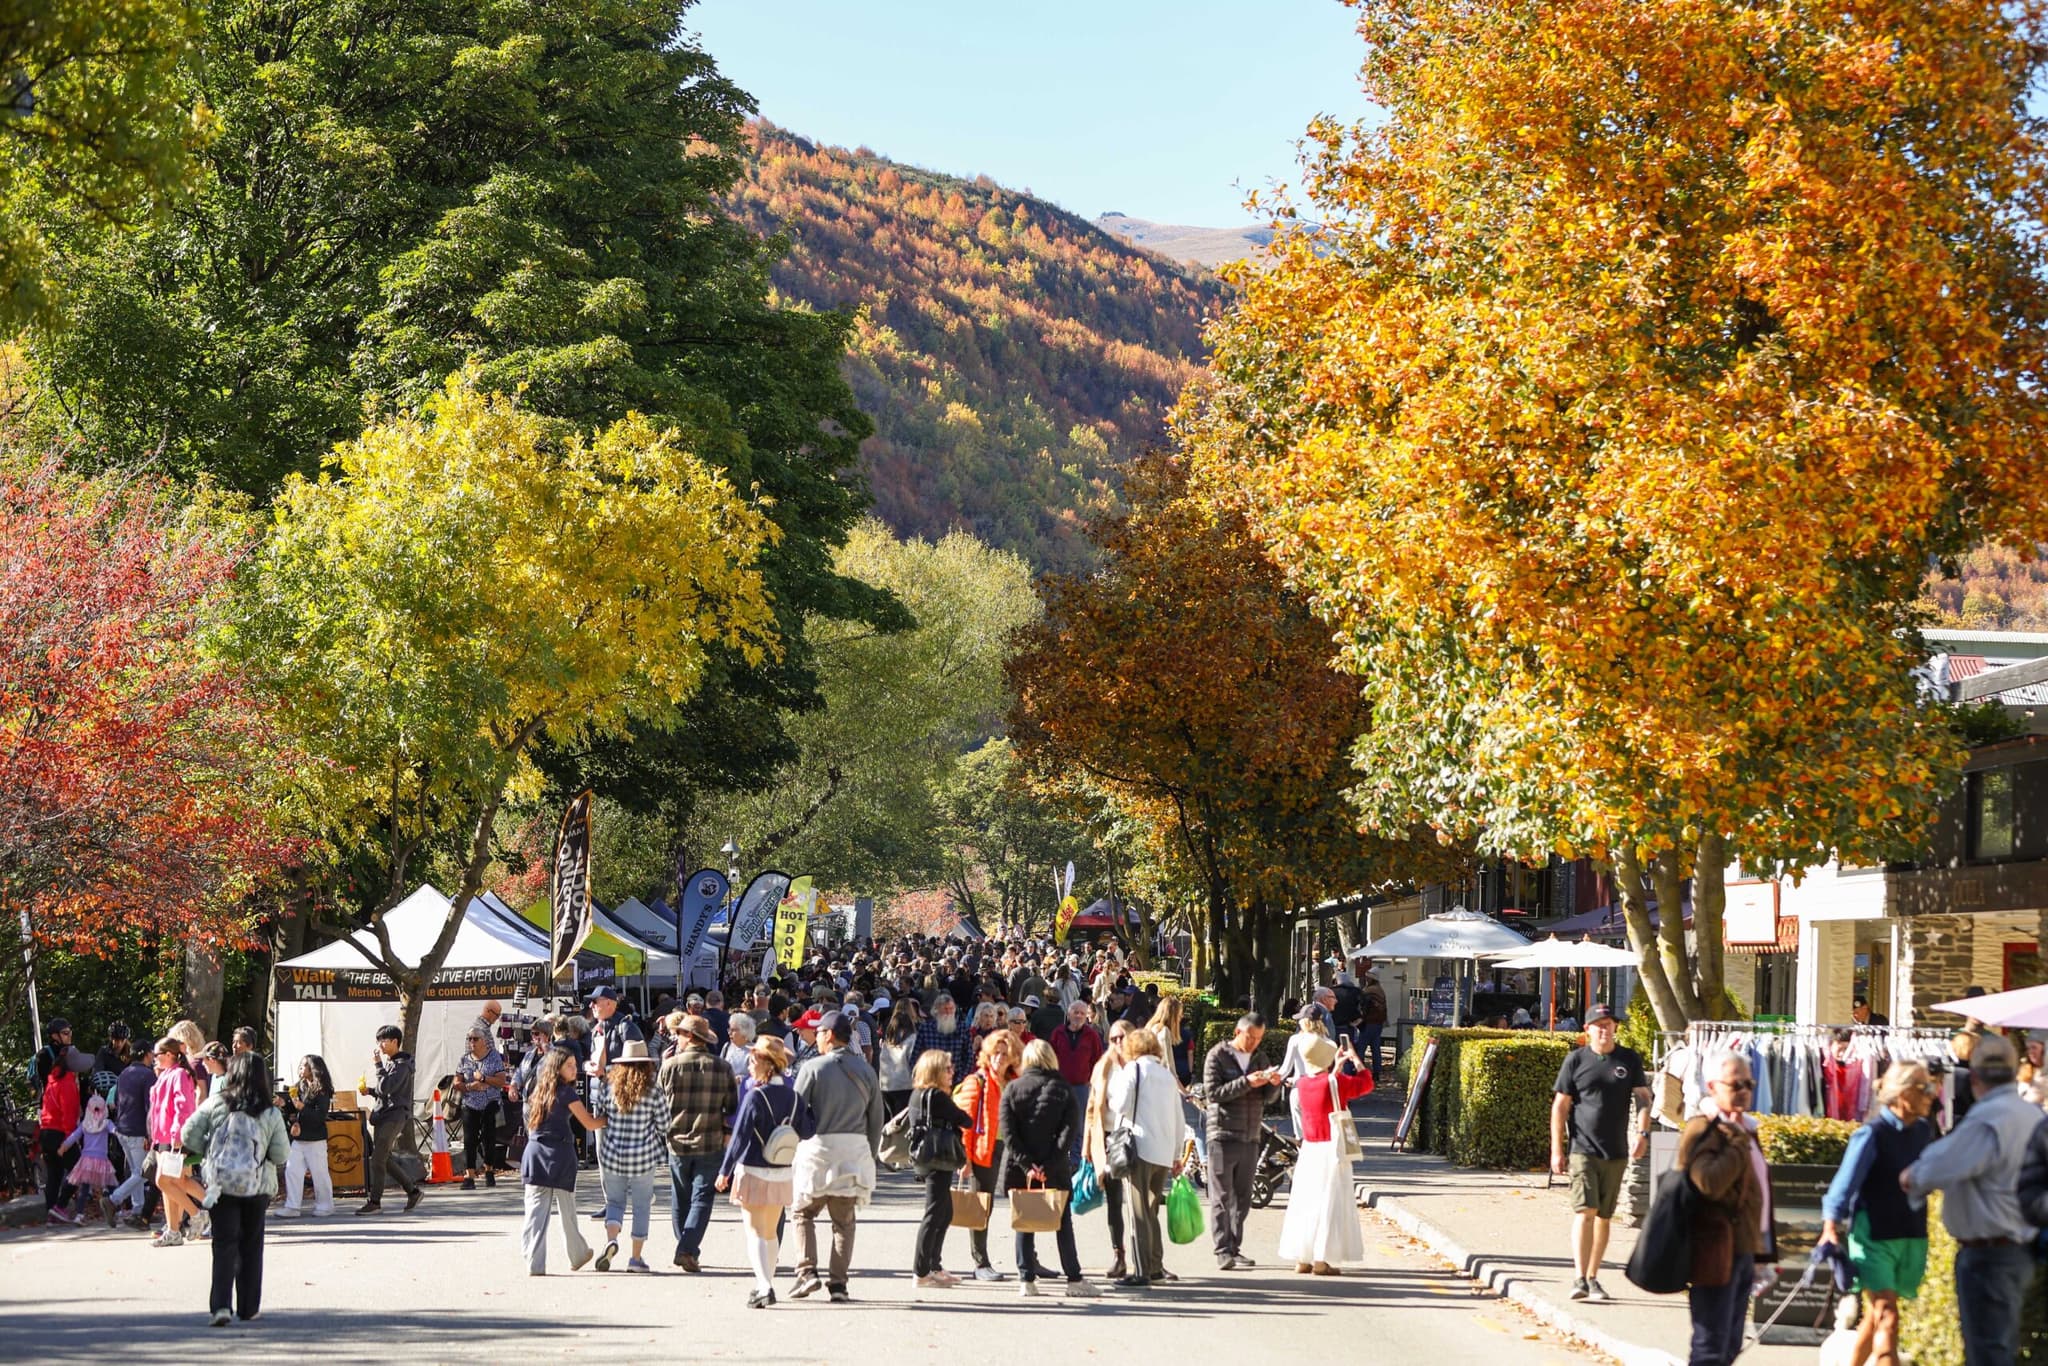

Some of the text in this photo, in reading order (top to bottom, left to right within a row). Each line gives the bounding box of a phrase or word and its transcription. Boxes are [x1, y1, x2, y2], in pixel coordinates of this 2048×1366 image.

[780, 911, 804, 920] HOT
[684, 904, 713, 957] SHANDY'S
[292, 968, 336, 983] Walk
[372, 972, 394, 985] BES
[441, 969, 463, 983] I'VE
[464, 968, 492, 982] EVER
[293, 984, 337, 1000] TALL
[348, 987, 381, 997] Merino
[438, 985, 478, 996] comfort
[480, 985, 488, 995] &
